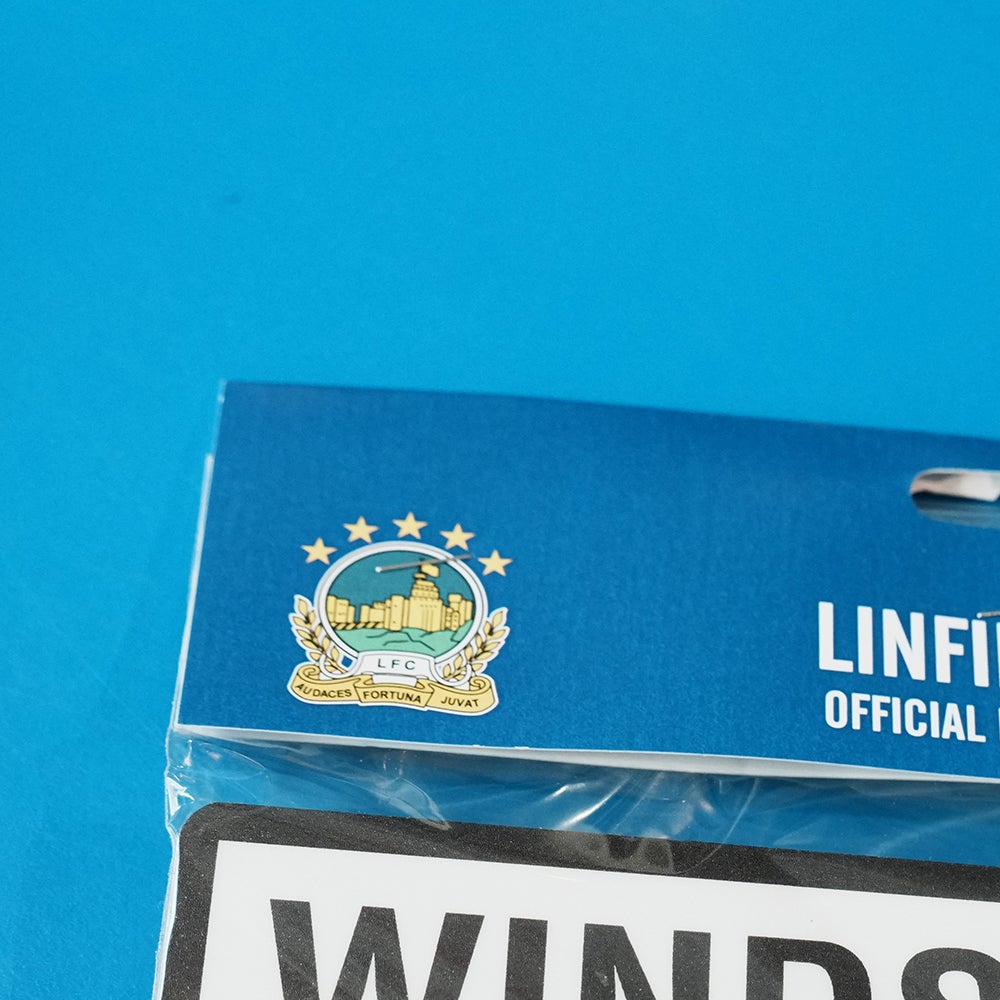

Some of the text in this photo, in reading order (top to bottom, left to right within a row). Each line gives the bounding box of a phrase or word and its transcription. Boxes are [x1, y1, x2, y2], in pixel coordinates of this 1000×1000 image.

[377, 658, 416, 671] LFC
[295, 682, 480, 708] AUDACES FORTUNA JUVAT
[824, 689, 986, 743] OFFICIAL
